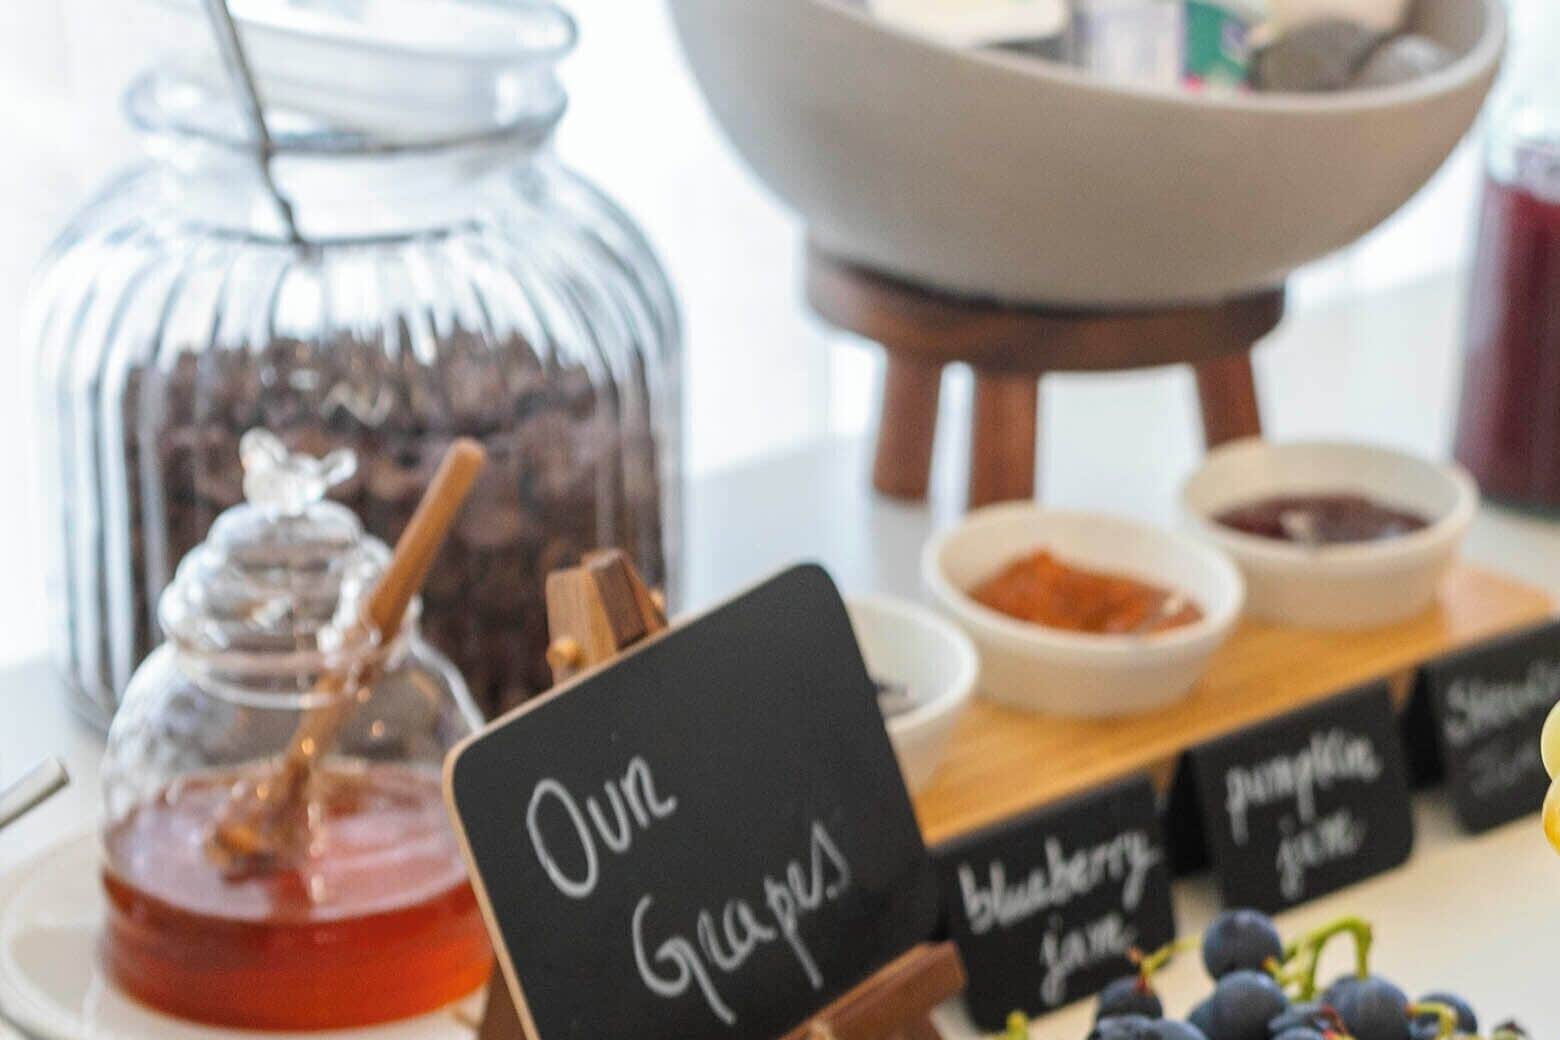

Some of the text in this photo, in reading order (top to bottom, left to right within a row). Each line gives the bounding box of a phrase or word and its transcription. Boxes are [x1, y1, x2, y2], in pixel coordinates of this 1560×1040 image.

[527, 756, 677, 898] Our
[1226, 727, 1381, 847] pumpkin
[631, 819, 850, 1025] Grapes
[957, 831, 1162, 934] blueberry
[1040, 912, 1137, 1004] jam
